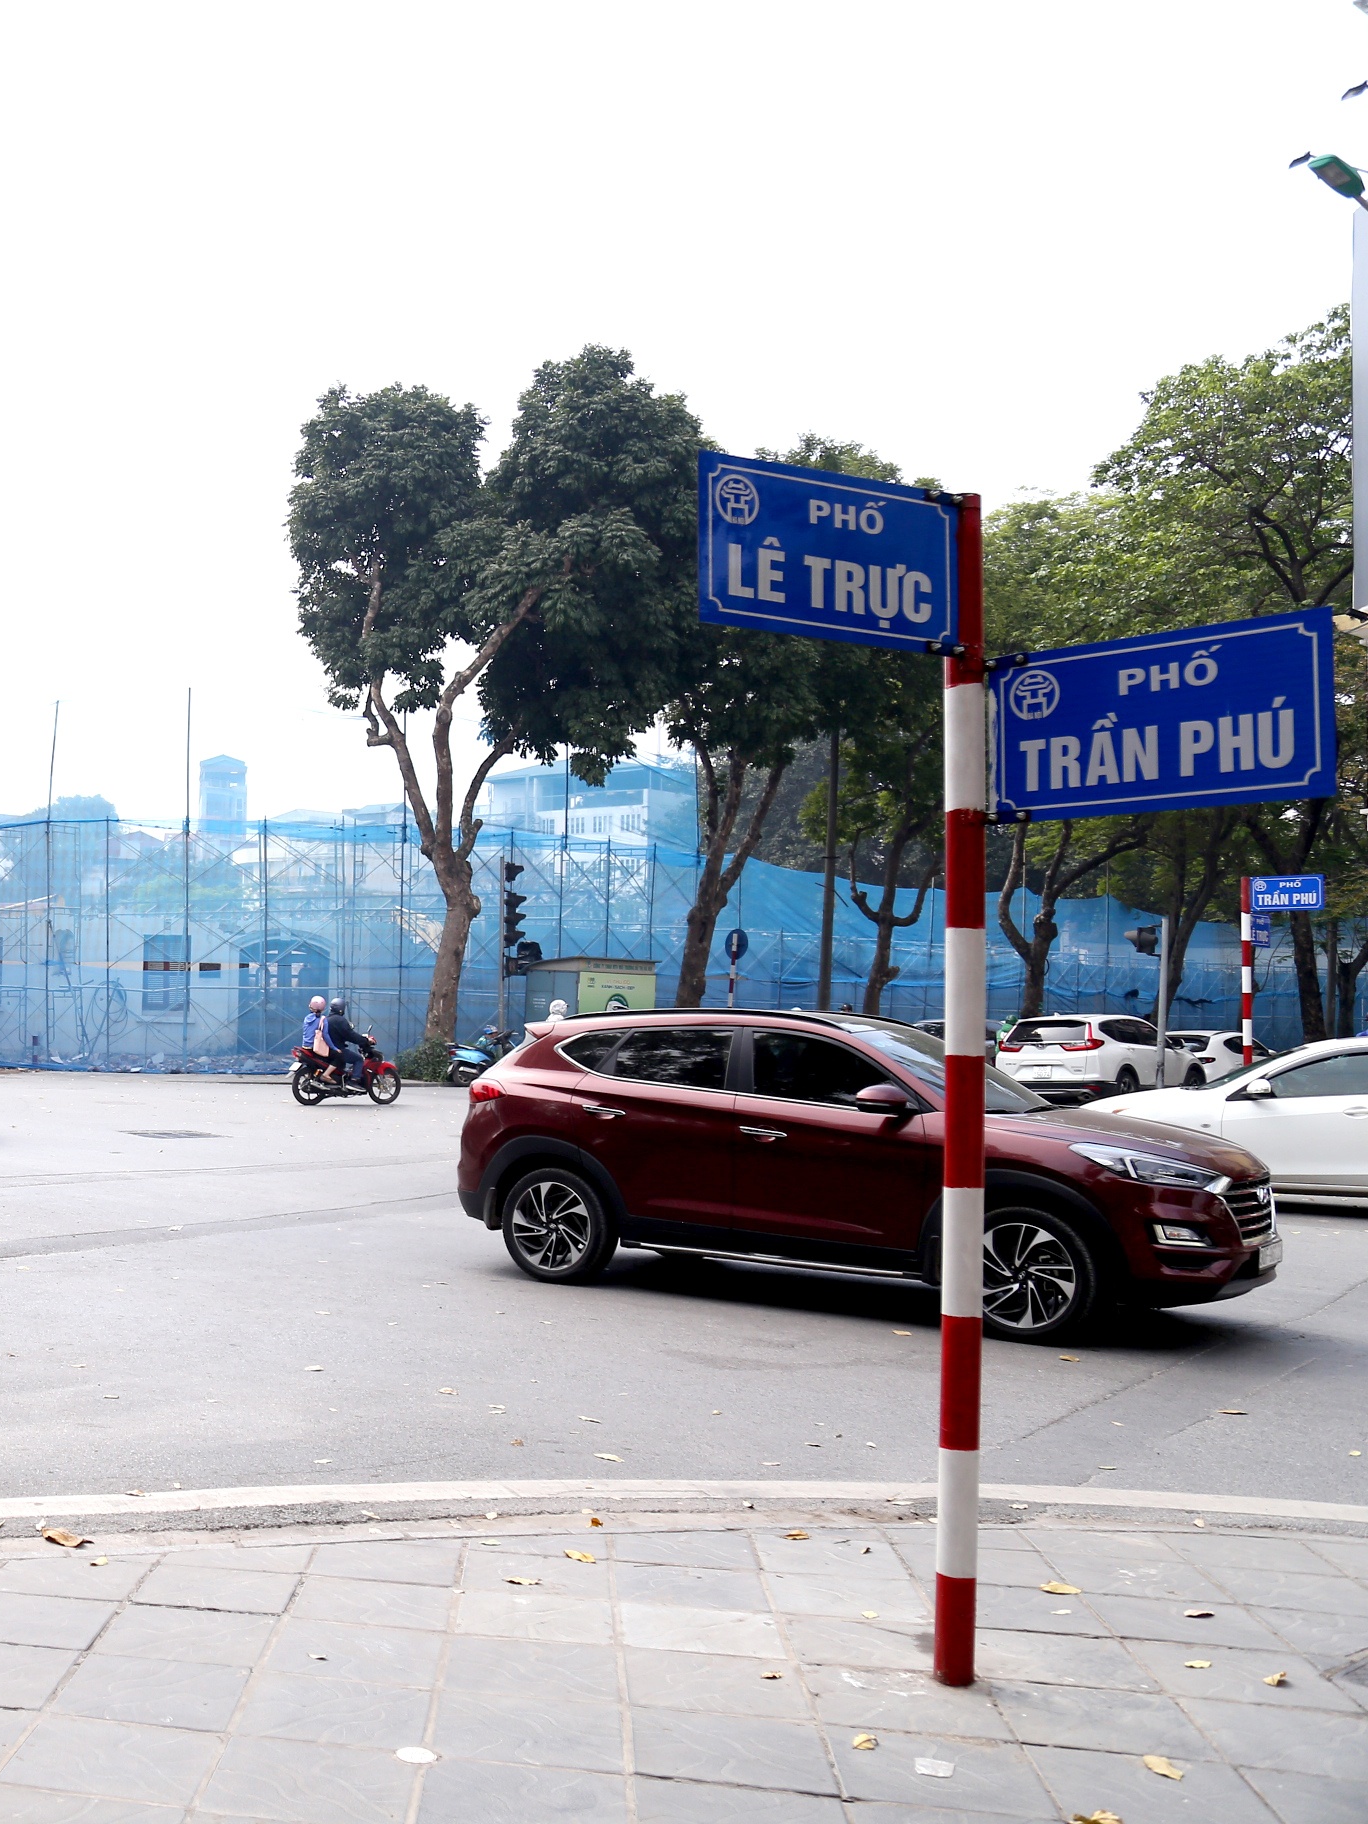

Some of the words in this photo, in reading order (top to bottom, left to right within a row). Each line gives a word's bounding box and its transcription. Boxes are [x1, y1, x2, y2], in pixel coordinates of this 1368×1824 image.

[808, 500, 886, 536] PHỐ
[728, 535, 786, 604] LÊ
[803, 554, 932, 630] TRỰC
[1117, 644, 1220, 696] PHỐ
[1019, 711, 1160, 792] TRẦN
[1179, 696, 1296, 778] PHÚ
[1257, 890, 1289, 905] TRẦN
[1292, 889, 1317, 905] PHÚ
[1279, 878, 1302, 888] PHỐ
